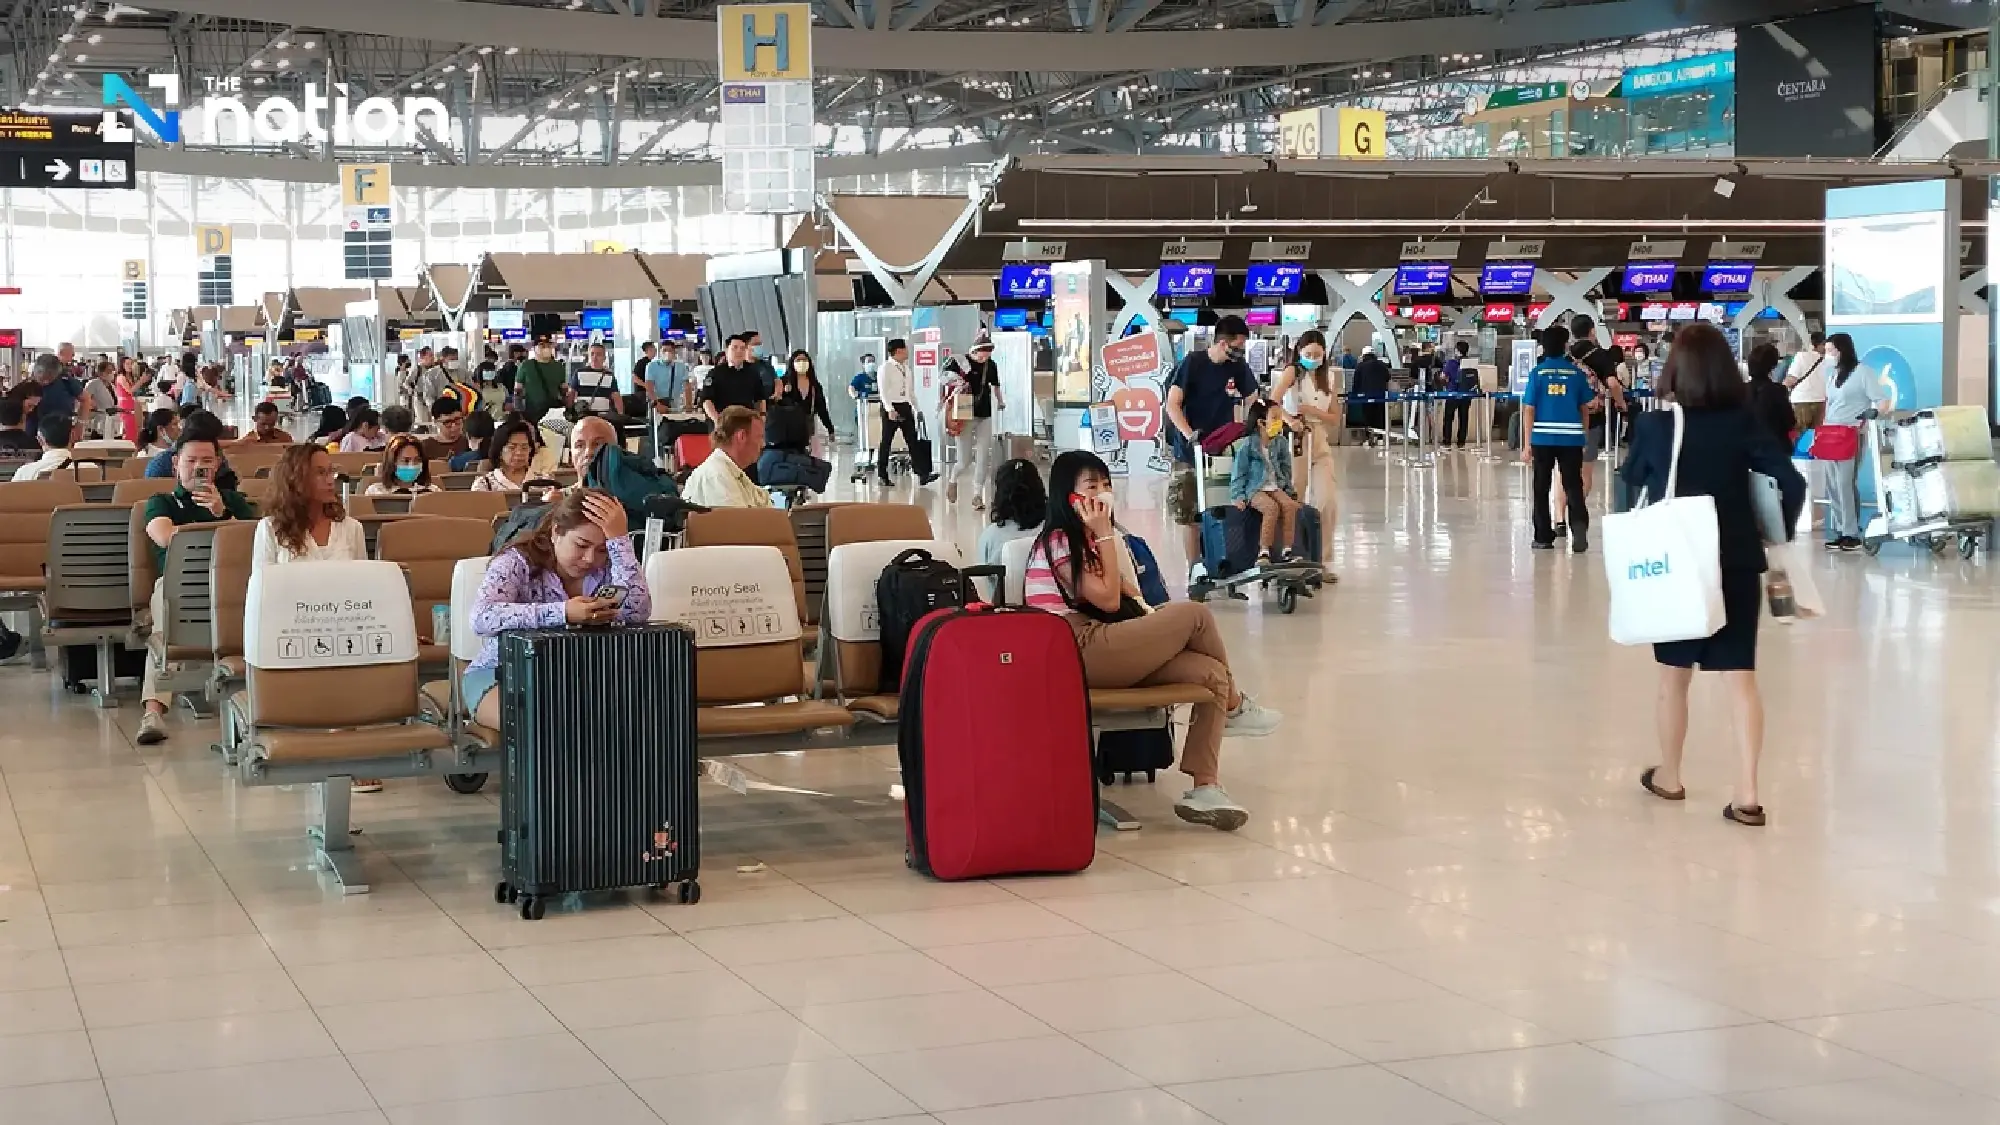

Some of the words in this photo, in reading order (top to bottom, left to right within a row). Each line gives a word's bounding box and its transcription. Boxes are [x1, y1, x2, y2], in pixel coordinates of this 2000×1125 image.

[743, 14, 789, 72] H
[739, 88, 761, 98] THAI
[1777, 78, 1826, 96] CENTARA
[1282, 121, 1316, 154] F/G
[1354, 121, 1372, 154] G
[354, 168, 378, 201] F
[204, 228, 225, 253] D
[1041, 245, 1063, 255] H01
[1165, 245, 1187, 255] H02
[1285, 245, 1307, 255] H03
[1405, 245, 1426, 255] H04
[1519, 244, 1539, 254] H05
[125, 260, 141, 278] B
[1644, 274, 1669, 284] THAI
[1722, 274, 1746, 284] THAI
[1628, 550, 1672, 580] intel
[691, 584, 730, 597] Priority
[733, 582, 761, 595] Seat
[296, 601, 339, 614] Priority
[344, 600, 374, 611] Seat
